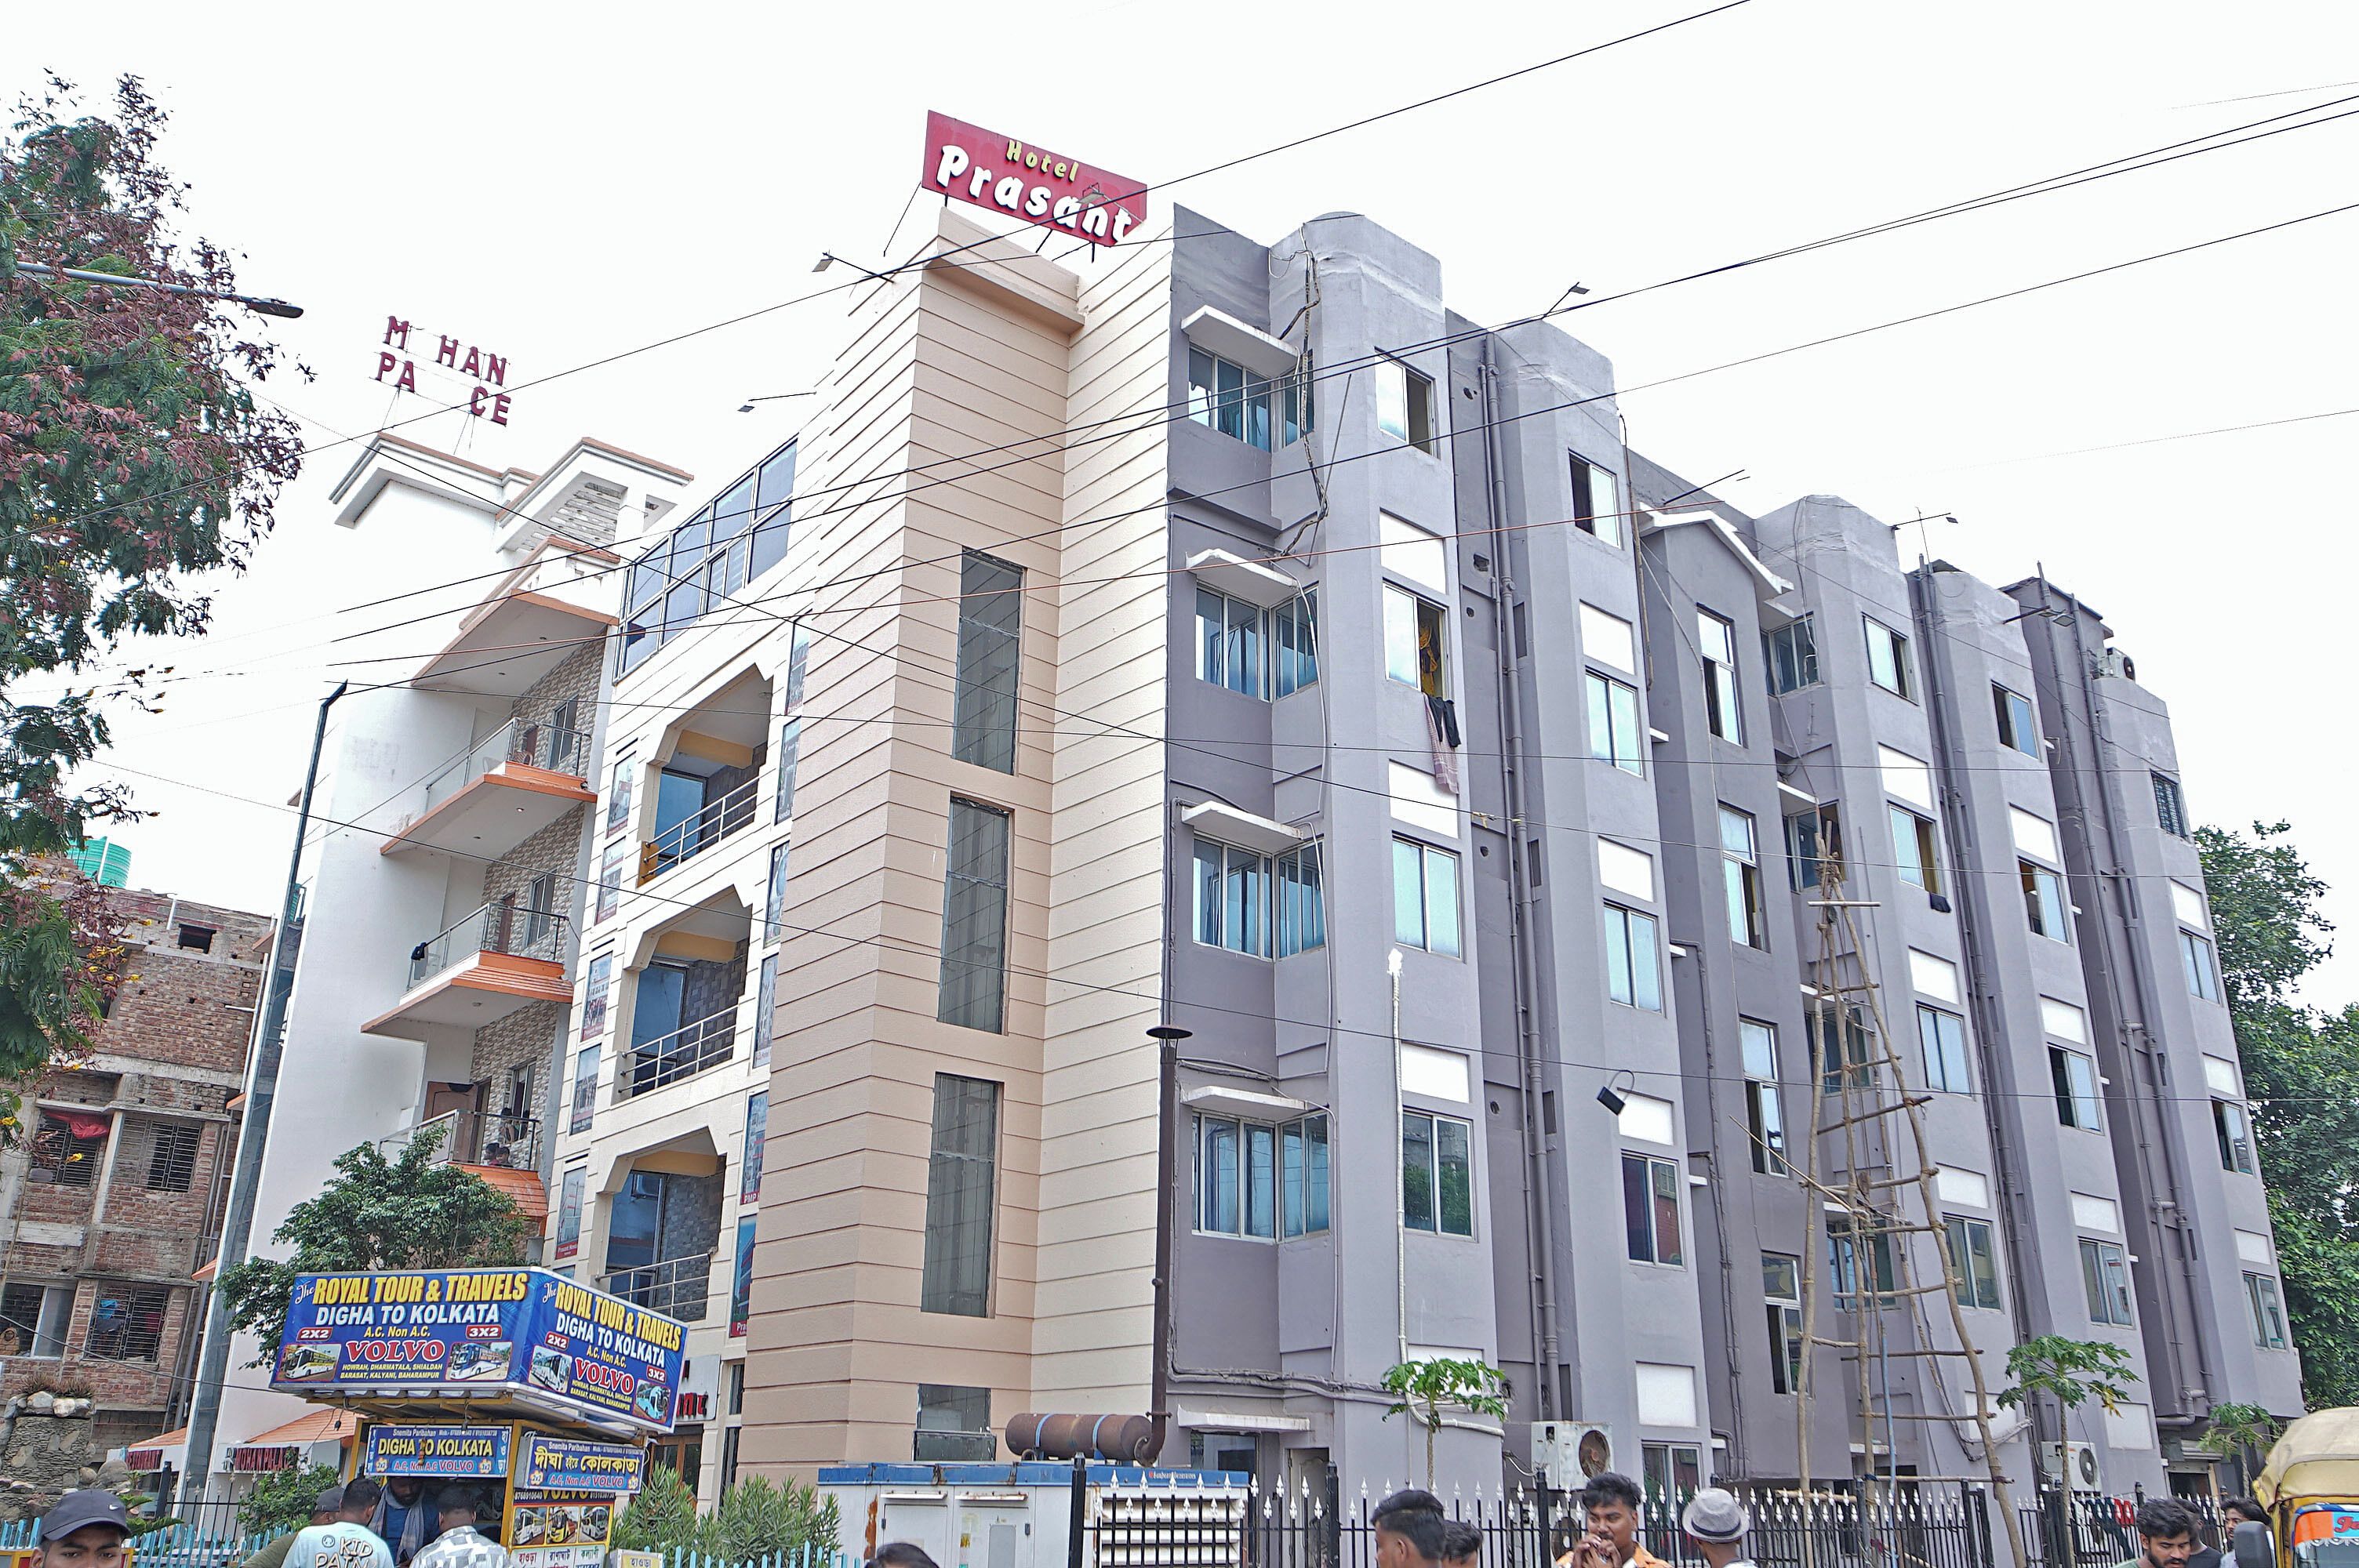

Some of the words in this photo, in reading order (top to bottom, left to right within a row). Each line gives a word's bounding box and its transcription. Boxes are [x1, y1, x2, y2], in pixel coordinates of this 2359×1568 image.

[1006, 139, 1079, 182] Hotel
[936, 145, 1132, 242] Prasant
[295, 1281, 314, 1305] The
[313, 1276, 369, 1305] ROYAL
[374, 1276, 426, 1304] TOUR
[426, 1278, 441, 1302] &
[445, 1272, 529, 1302] TRAVELS
[315, 1305, 375, 1327] DIGHA
[380, 1305, 405, 1325] TO
[409, 1304, 500, 1324] KOLKATA
[542, 1281, 557, 1303] The
[554, 1282, 592, 1319] ROYAL
[594, 1296, 626, 1329] TOUR
[624, 1312, 634, 1335] &
[636, 1311, 682, 1352] TRAVELS
[300, 1328, 330, 1339] 2X2
[388, 1327, 408, 1337] Non
[409, 1326, 431, 1337] A.C.
[469, 1327, 500, 1338] 3X2
[547, 1335, 567, 1349] 2X2
[556, 1312, 594, 1345] DIGHA
[598, 1327, 613, 1348] TO
[615, 1333, 665, 1368] KOLKATA
[346, 1340, 445, 1363] VOLVO
[602, 1351, 613, 1363] Non
[574, 1357, 634, 1395] VOLVO
[648, 1368, 665, 1381] 3X2
[378, 1438, 415, 1455] DIGHA
[437, 1439, 493, 1456] KOLKATA
[235, 1447, 262, 1472] MOHAN
[409, 1461, 423, 1471] Non
[438, 1461, 474, 1472] VOLVO
[534, 1446, 563, 1470] দীঘা
[581, 1454, 641, 1475] কোলকাতা
[566, 1476, 579, 1486] Non
[593, 1475, 624, 1487] VOLVO
[340, 1537, 373, 1558] KID
[315, 1552, 369, 1568] PAIN
